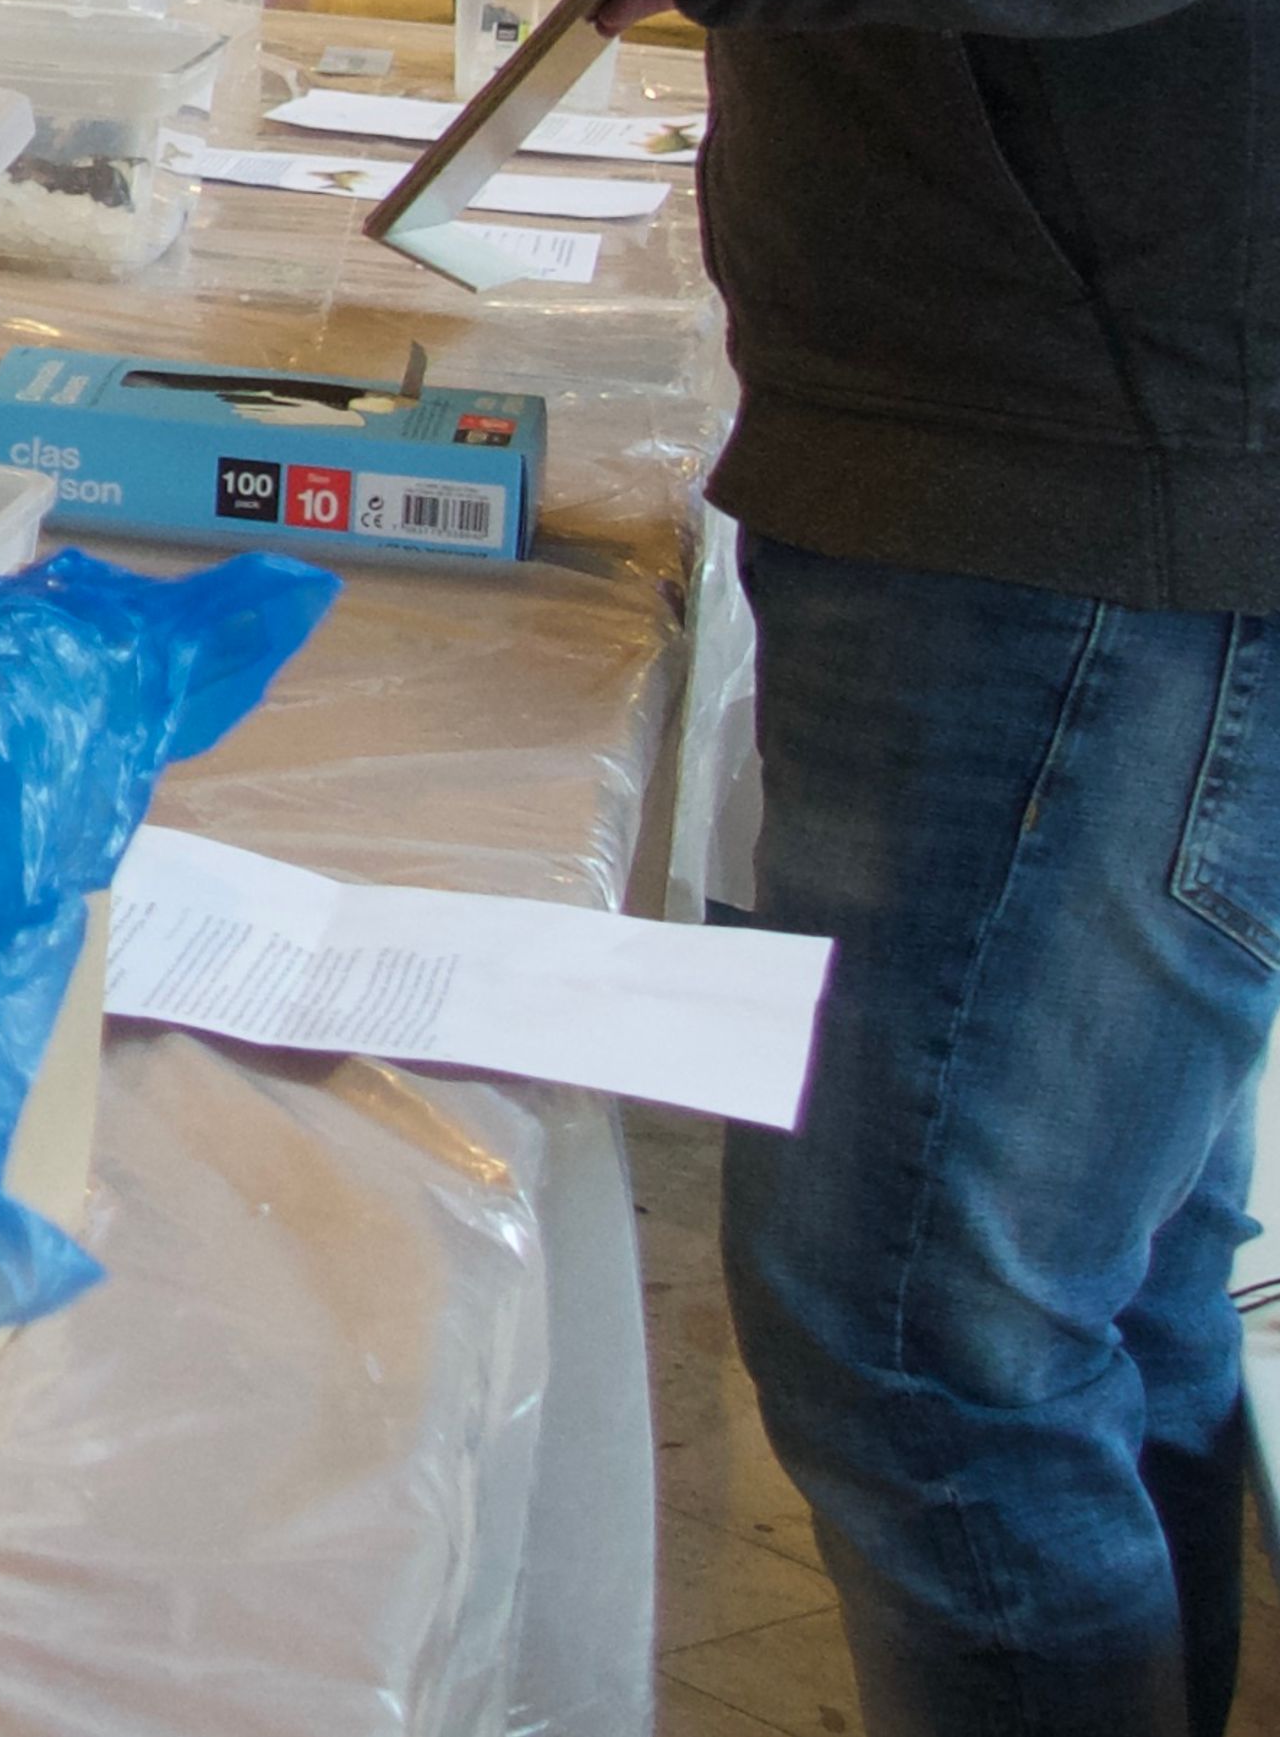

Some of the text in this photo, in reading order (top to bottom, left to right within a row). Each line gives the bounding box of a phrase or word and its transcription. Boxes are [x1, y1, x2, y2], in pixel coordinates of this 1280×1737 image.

[9, 435, 82, 471] clas
[222, 470, 274, 498] 100
[296, 487, 339, 524] 10
